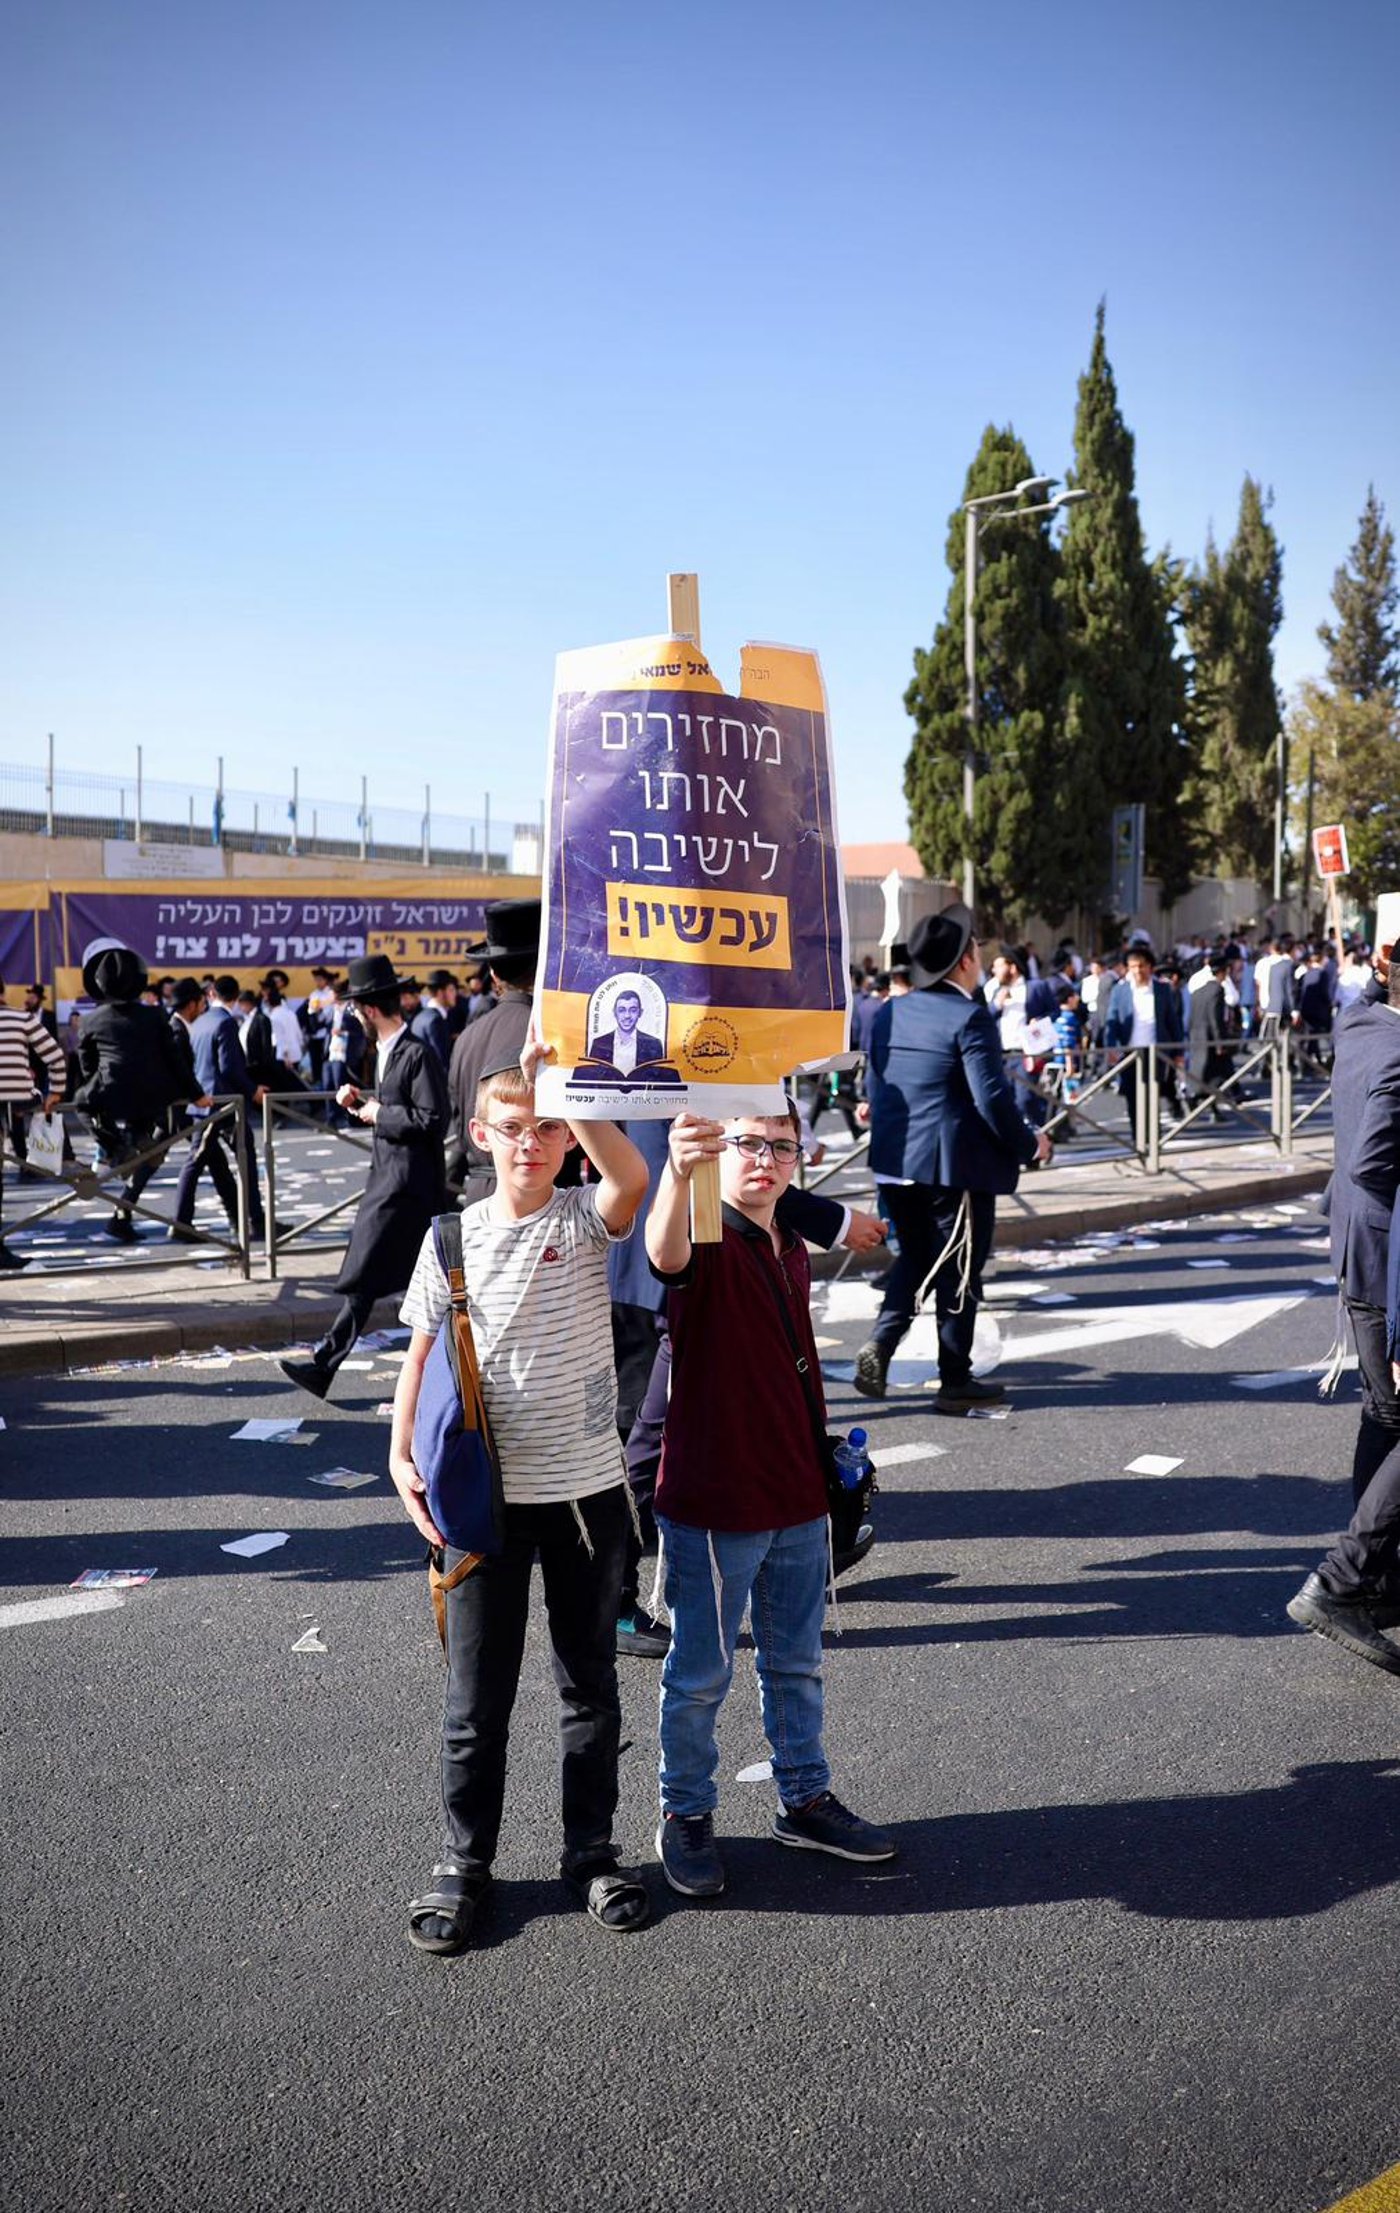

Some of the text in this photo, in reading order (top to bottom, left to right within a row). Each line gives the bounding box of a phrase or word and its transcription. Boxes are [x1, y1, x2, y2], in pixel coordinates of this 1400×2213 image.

[600, 711, 782, 765] מחזירים
[638, 770, 749, 818] אותו
[609, 830, 780, 881] לישיבה
[158, 900, 242, 926] העליה
[251, 901, 293, 929] לבן
[302, 904, 385, 929] זועקים
[391, 902, 469, 925] ישראל
[618, 896, 778, 952] עכשיו!
[155, 935, 209, 959] צר!
[216, 933, 262, 958] לנו
